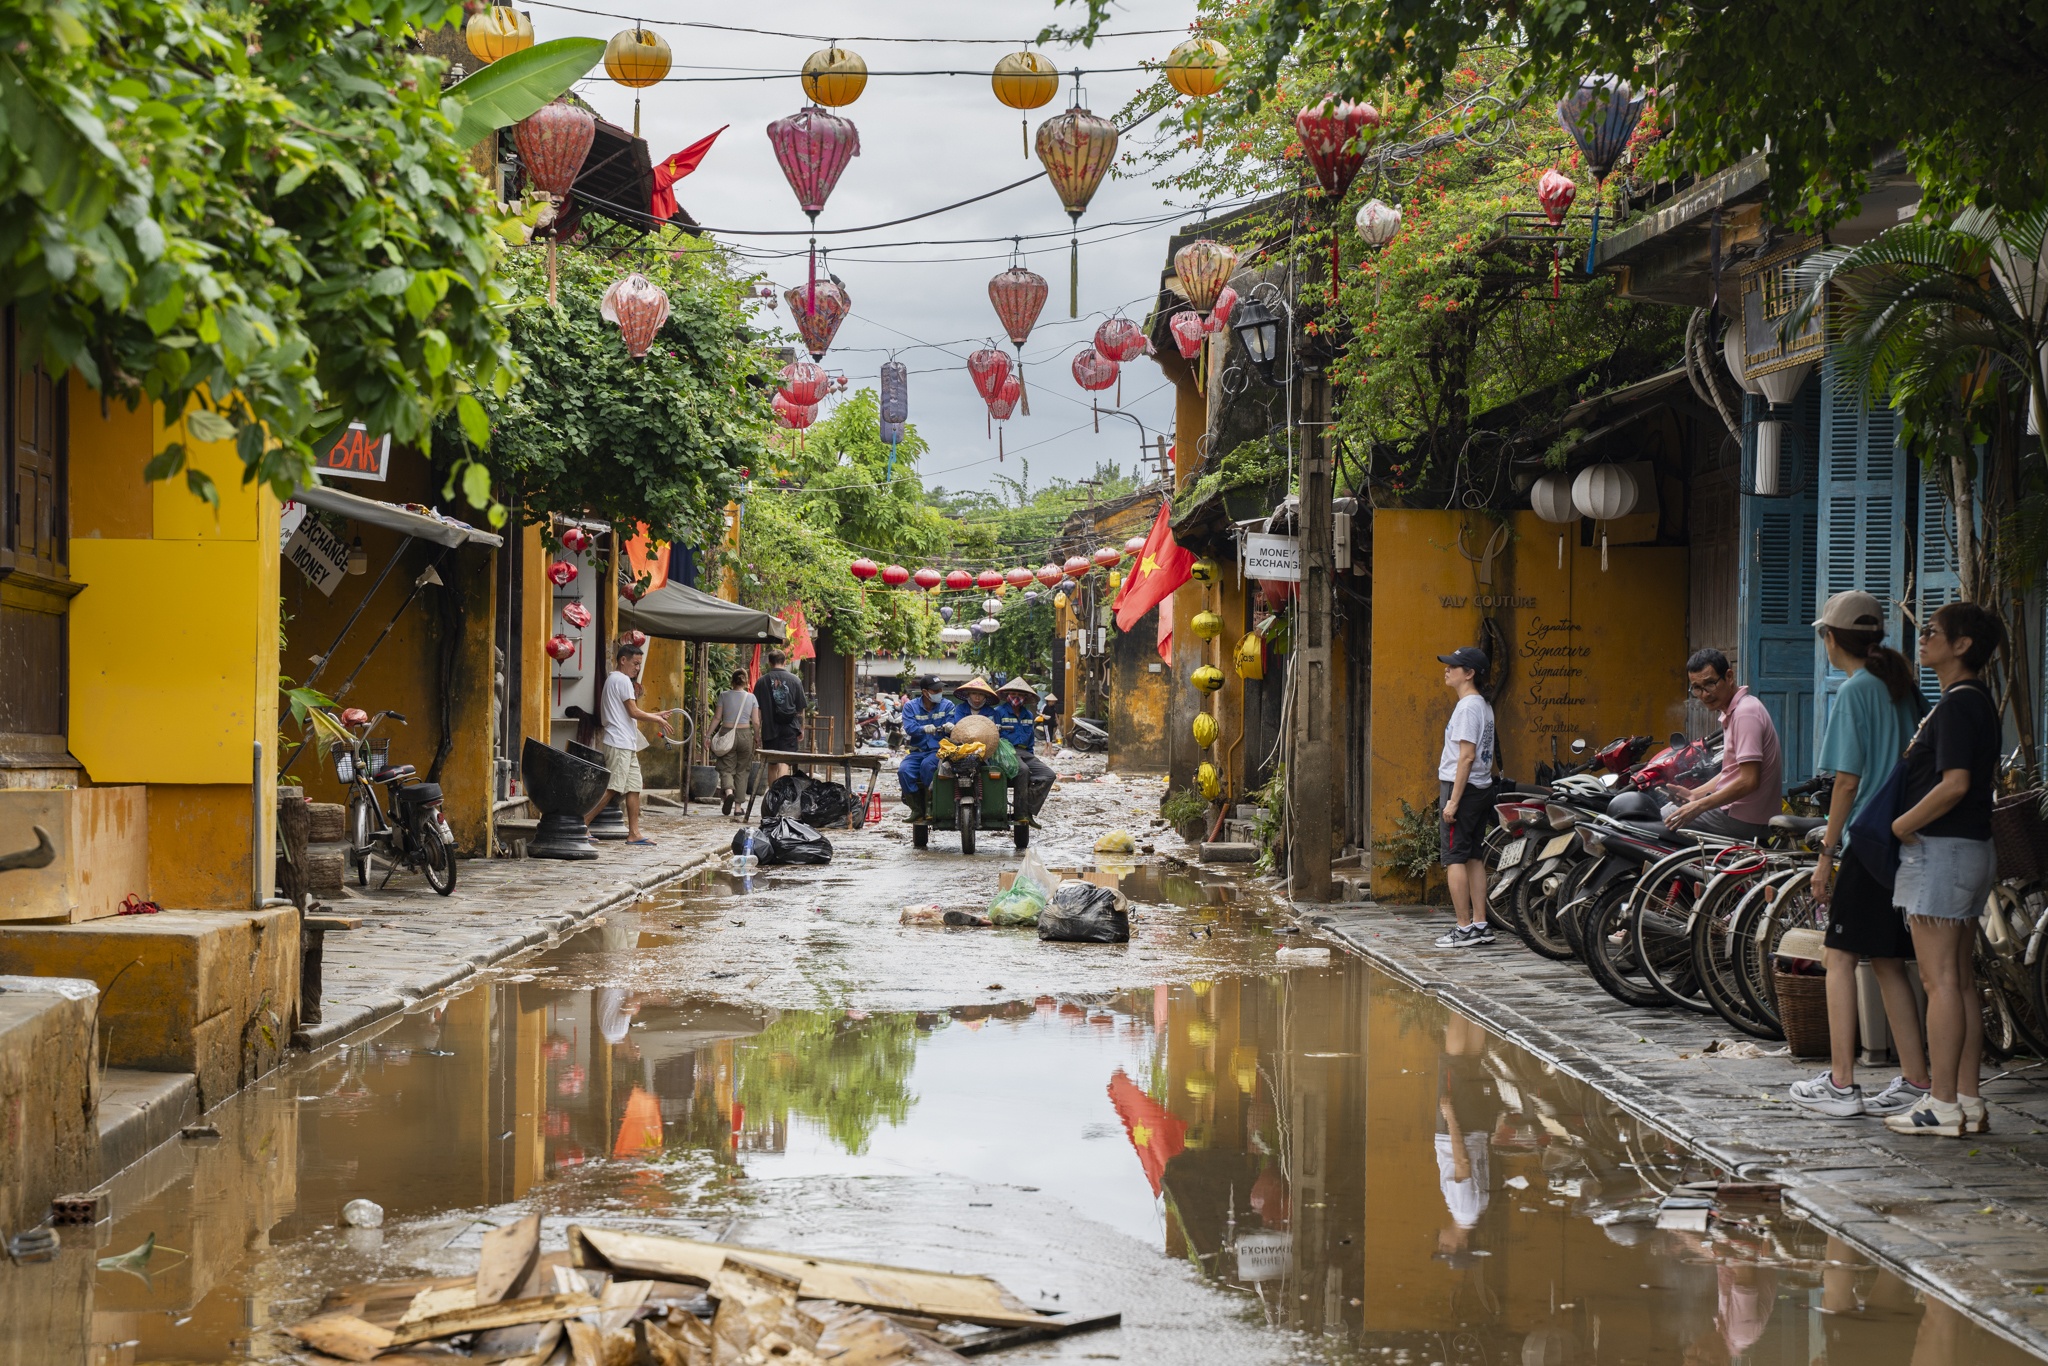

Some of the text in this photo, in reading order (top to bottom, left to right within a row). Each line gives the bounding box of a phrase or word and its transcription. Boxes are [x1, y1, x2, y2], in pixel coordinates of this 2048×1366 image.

[299, 514, 349, 573] EXCHANGE
[291, 544, 331, 586] MONEY
[1249, 558, 1301, 570] EXCHANG
[1438, 595, 1537, 609] YALY COUTURE
[1527, 616, 1582, 640] Signature
[1519, 639, 1591, 662] Signature
[1528, 660, 1583, 685] Signature
[1523, 685, 1586, 711] Signature
[1529, 716, 1580, 742] Signature
